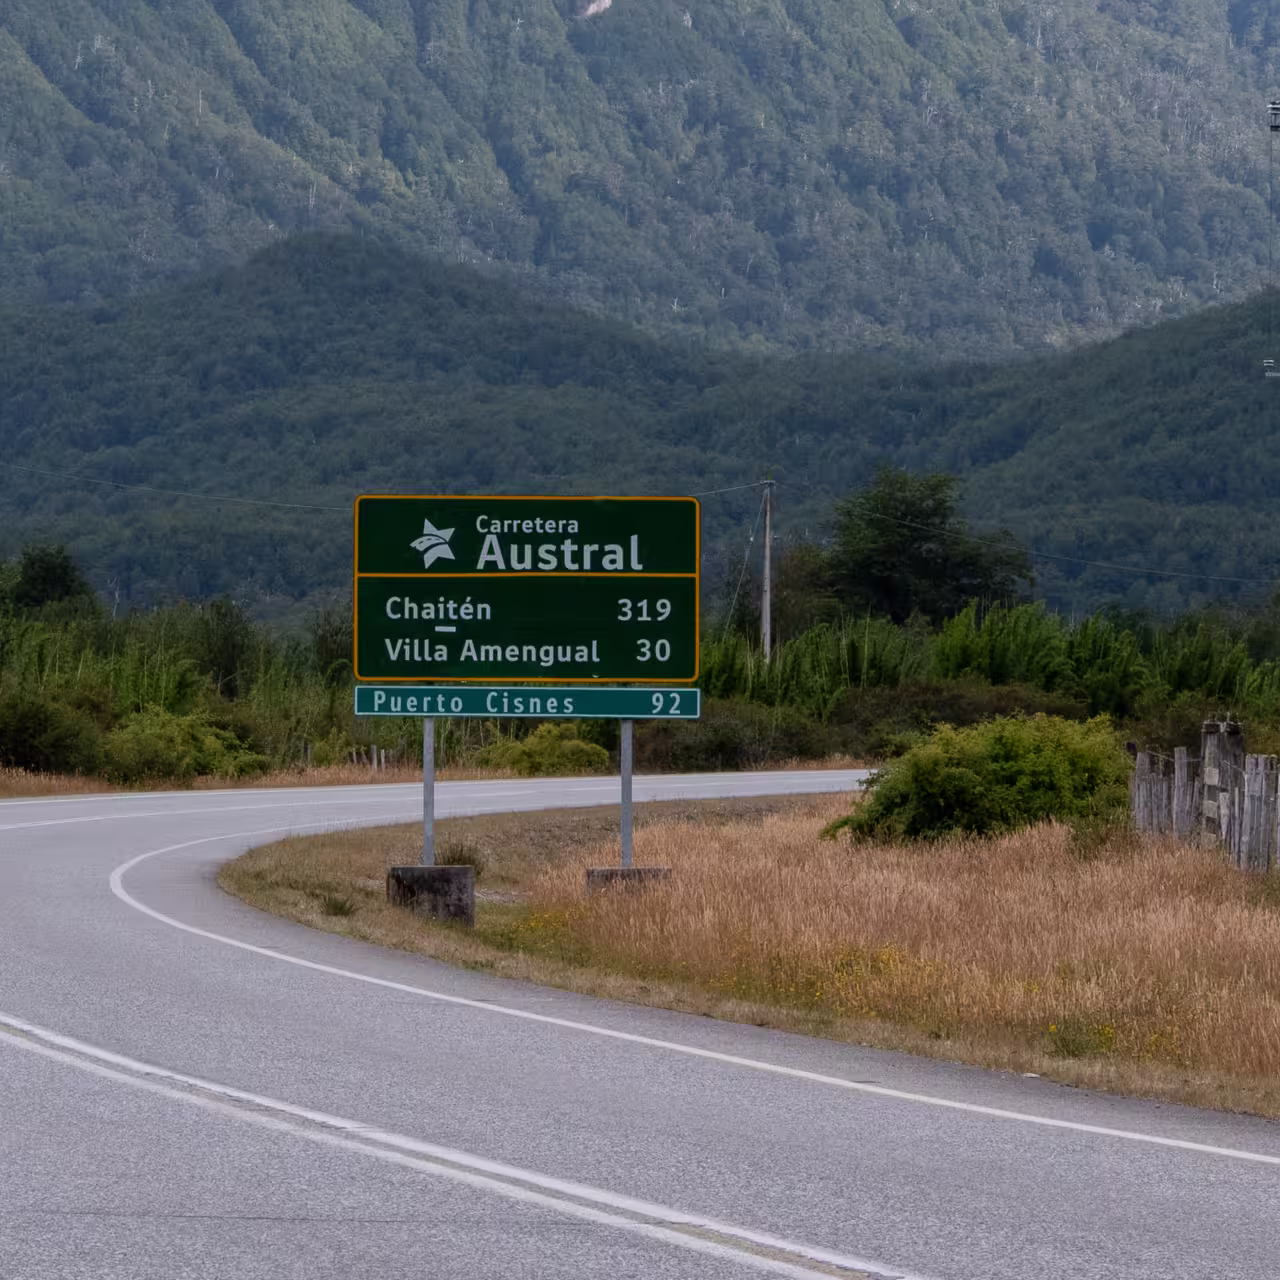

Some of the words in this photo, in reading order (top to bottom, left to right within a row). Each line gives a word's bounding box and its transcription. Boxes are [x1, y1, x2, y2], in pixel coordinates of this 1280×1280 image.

[476, 515, 579, 533] Carretera
[476, 534, 643, 570] Austral
[386, 596, 491, 620] Chaitén
[617, 599, 672, 621] 319
[385, 638, 448, 661] Villa
[460, 639, 600, 667] Amengual
[636, 639, 671, 661] 30
[373, 690, 463, 712] Puerto
[486, 692, 574, 714] Cisnes
[651, 693, 681, 715] 92
